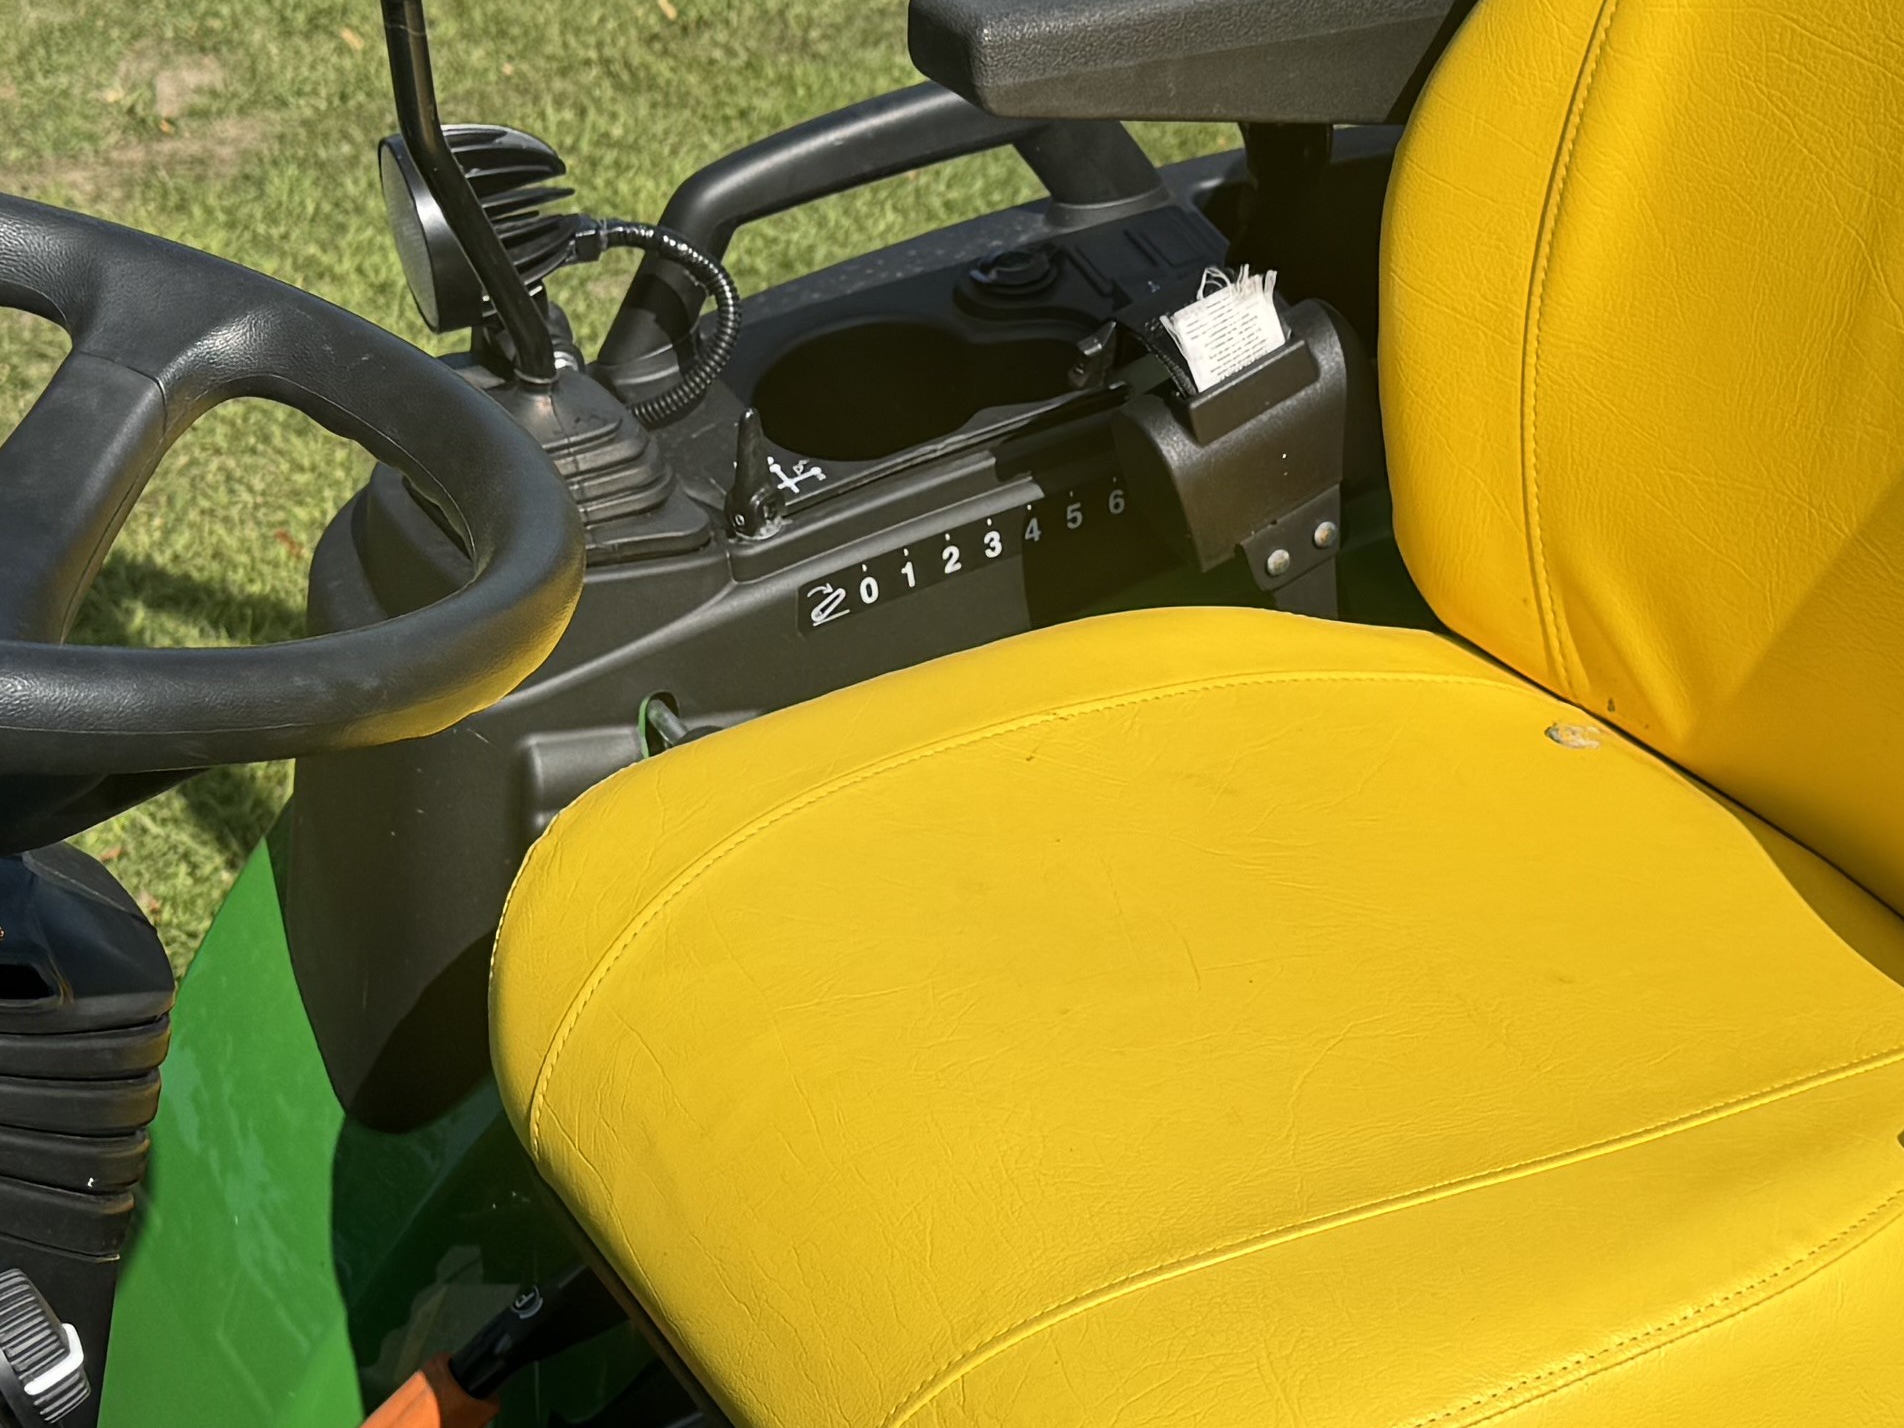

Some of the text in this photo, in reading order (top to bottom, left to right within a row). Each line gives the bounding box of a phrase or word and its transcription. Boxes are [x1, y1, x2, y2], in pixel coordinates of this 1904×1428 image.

[859, 489, 1126, 604] 0 1 2 3 4 5 6
